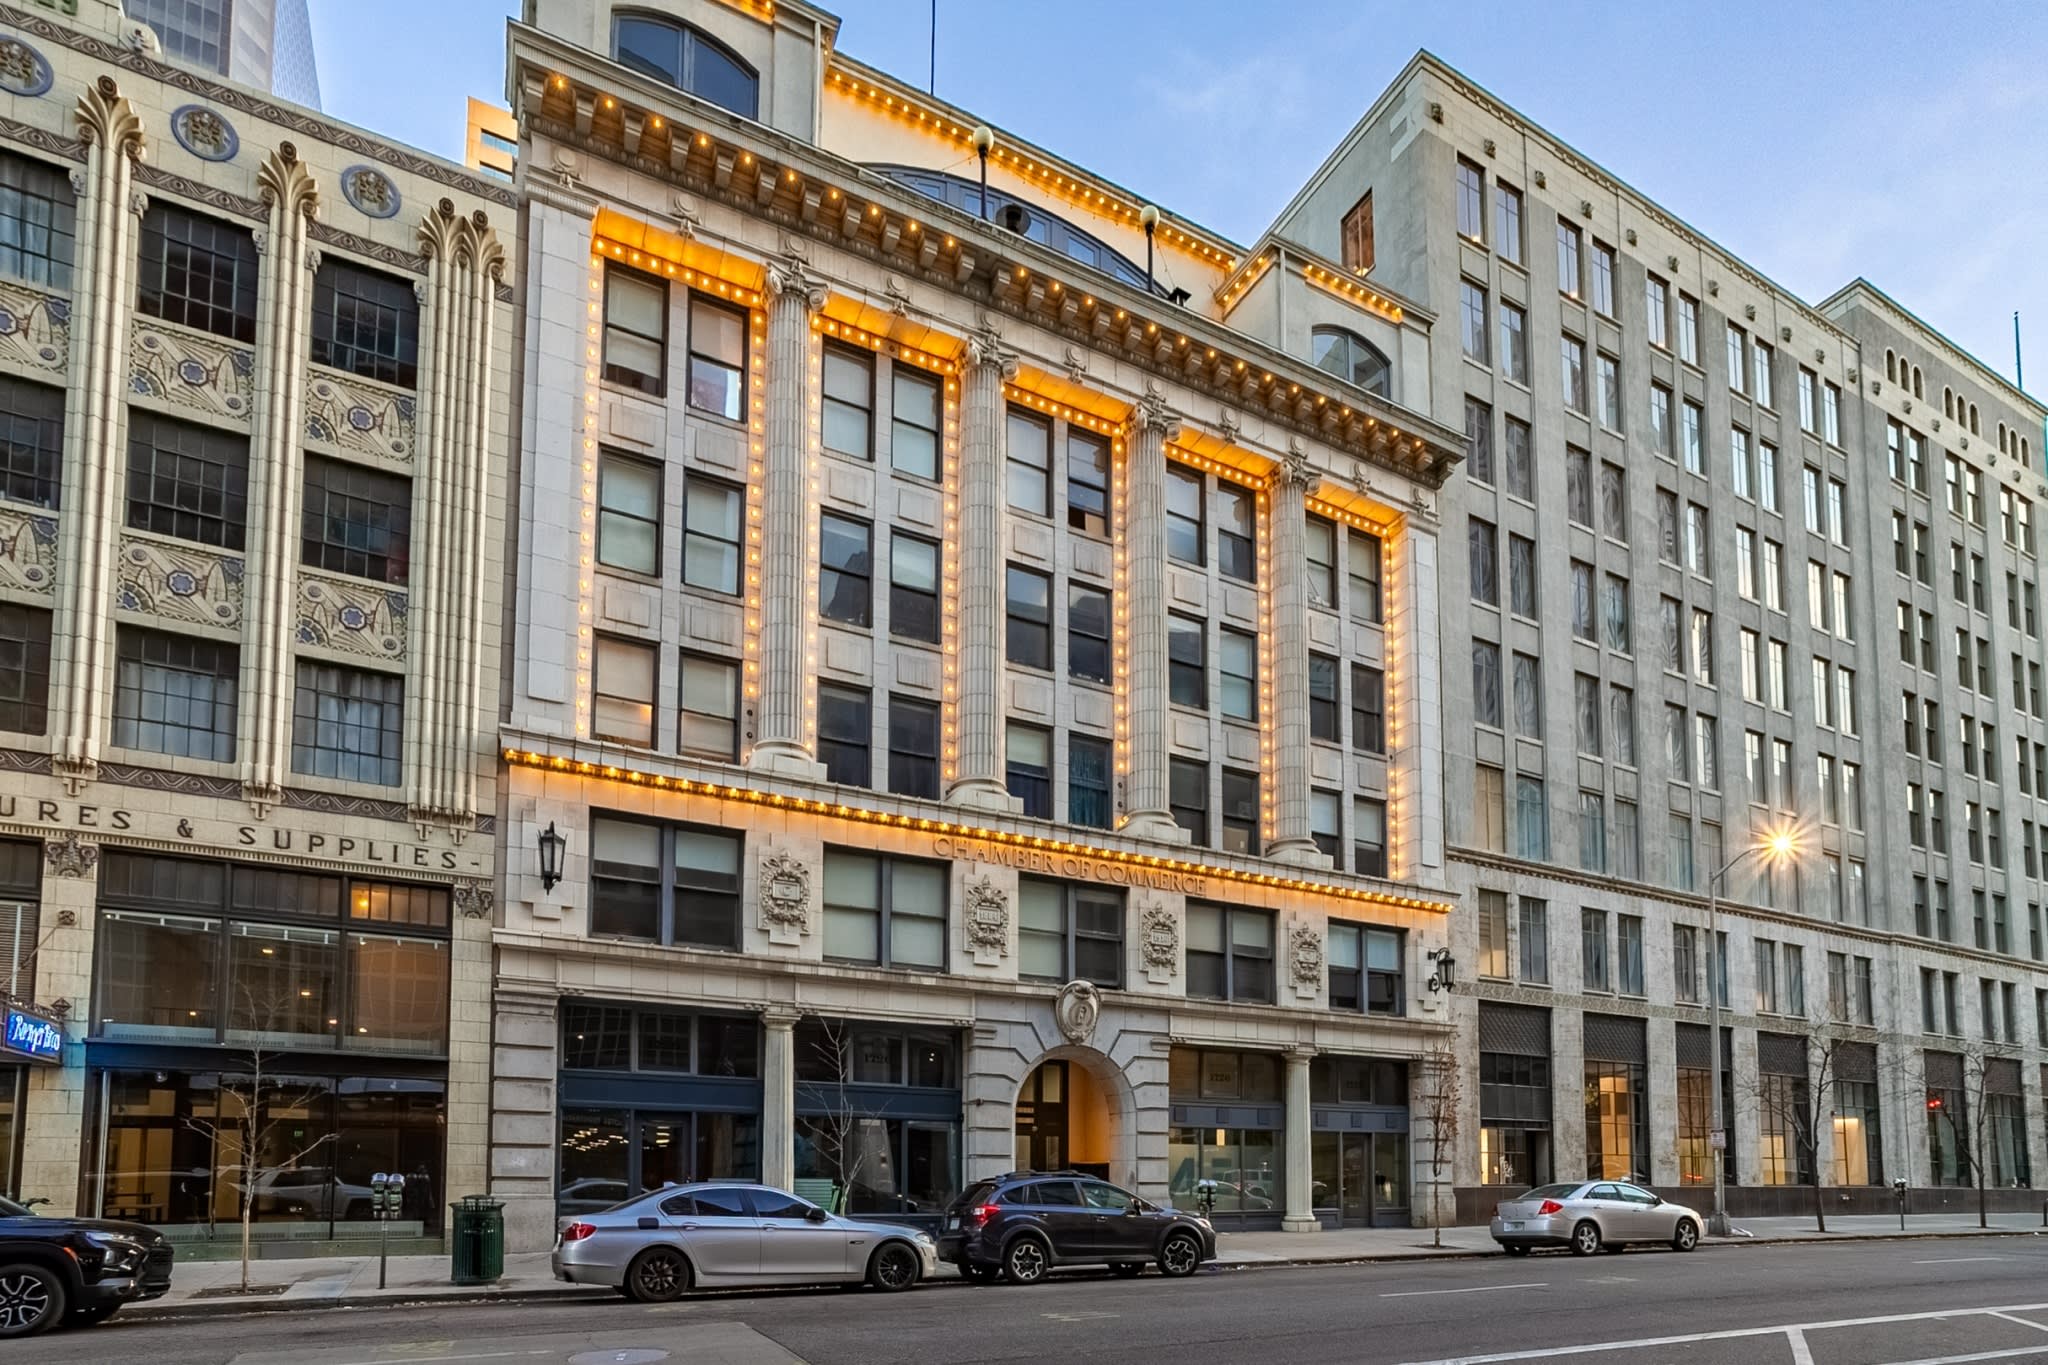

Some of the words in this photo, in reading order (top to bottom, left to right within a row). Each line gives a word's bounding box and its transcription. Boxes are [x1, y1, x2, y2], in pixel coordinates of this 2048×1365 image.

[0, 795, 132, 830] URES
[176, 818, 194, 839] &
[933, 837, 1057, 873] CHAMBER
[1063, 858, 1092, 878] OF
[1095, 864, 1207, 896] COMMERCE
